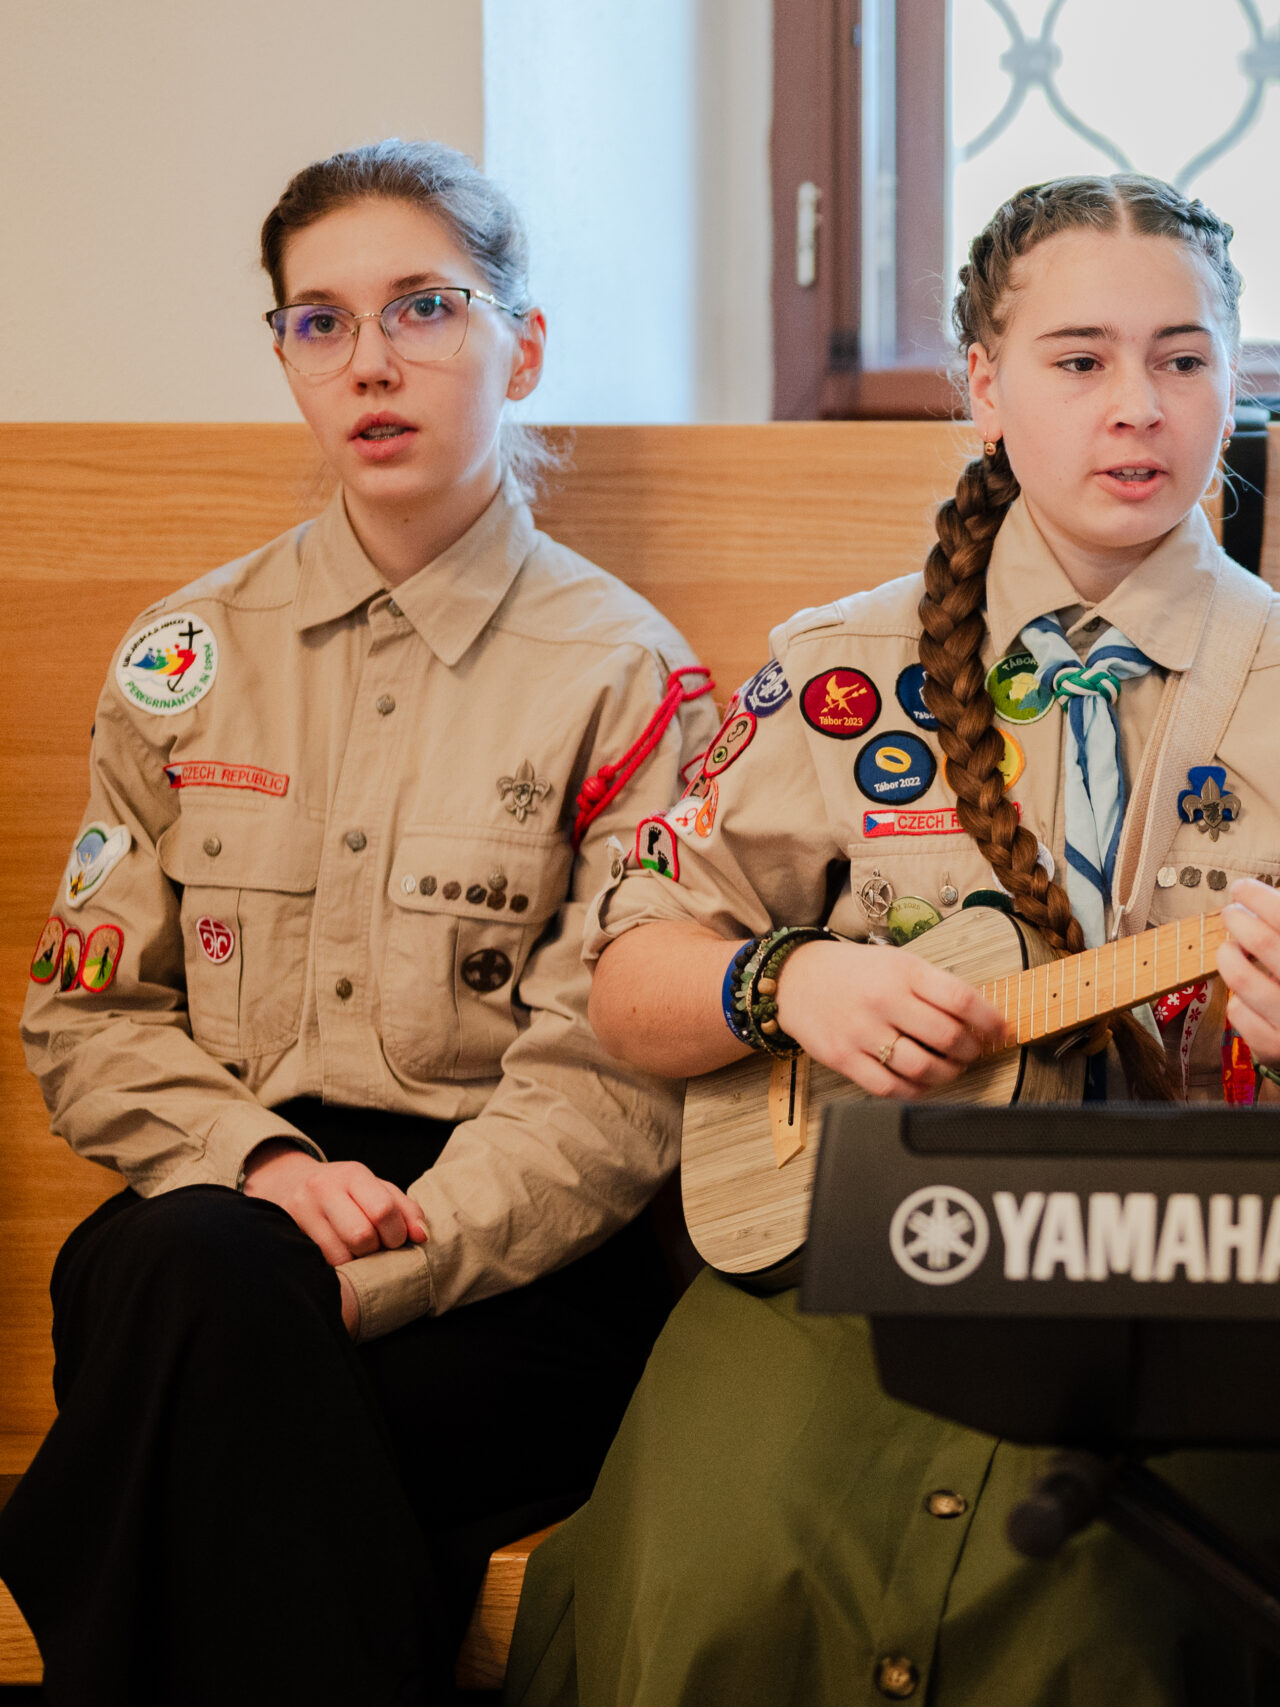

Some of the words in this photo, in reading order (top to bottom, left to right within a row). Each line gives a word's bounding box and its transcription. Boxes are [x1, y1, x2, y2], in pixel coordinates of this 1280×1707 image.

[819, 715, 842, 726] Tábor
[844, 716, 863, 727] 2023
[913, 711, 936, 720] Tábo
[182, 765, 216, 781] CZECH
[221, 767, 283, 791] REPUBLIC
[874, 778, 899, 793] Tábor
[899, 776, 921, 788] 2022
[897, 814, 945, 830] CZECH
